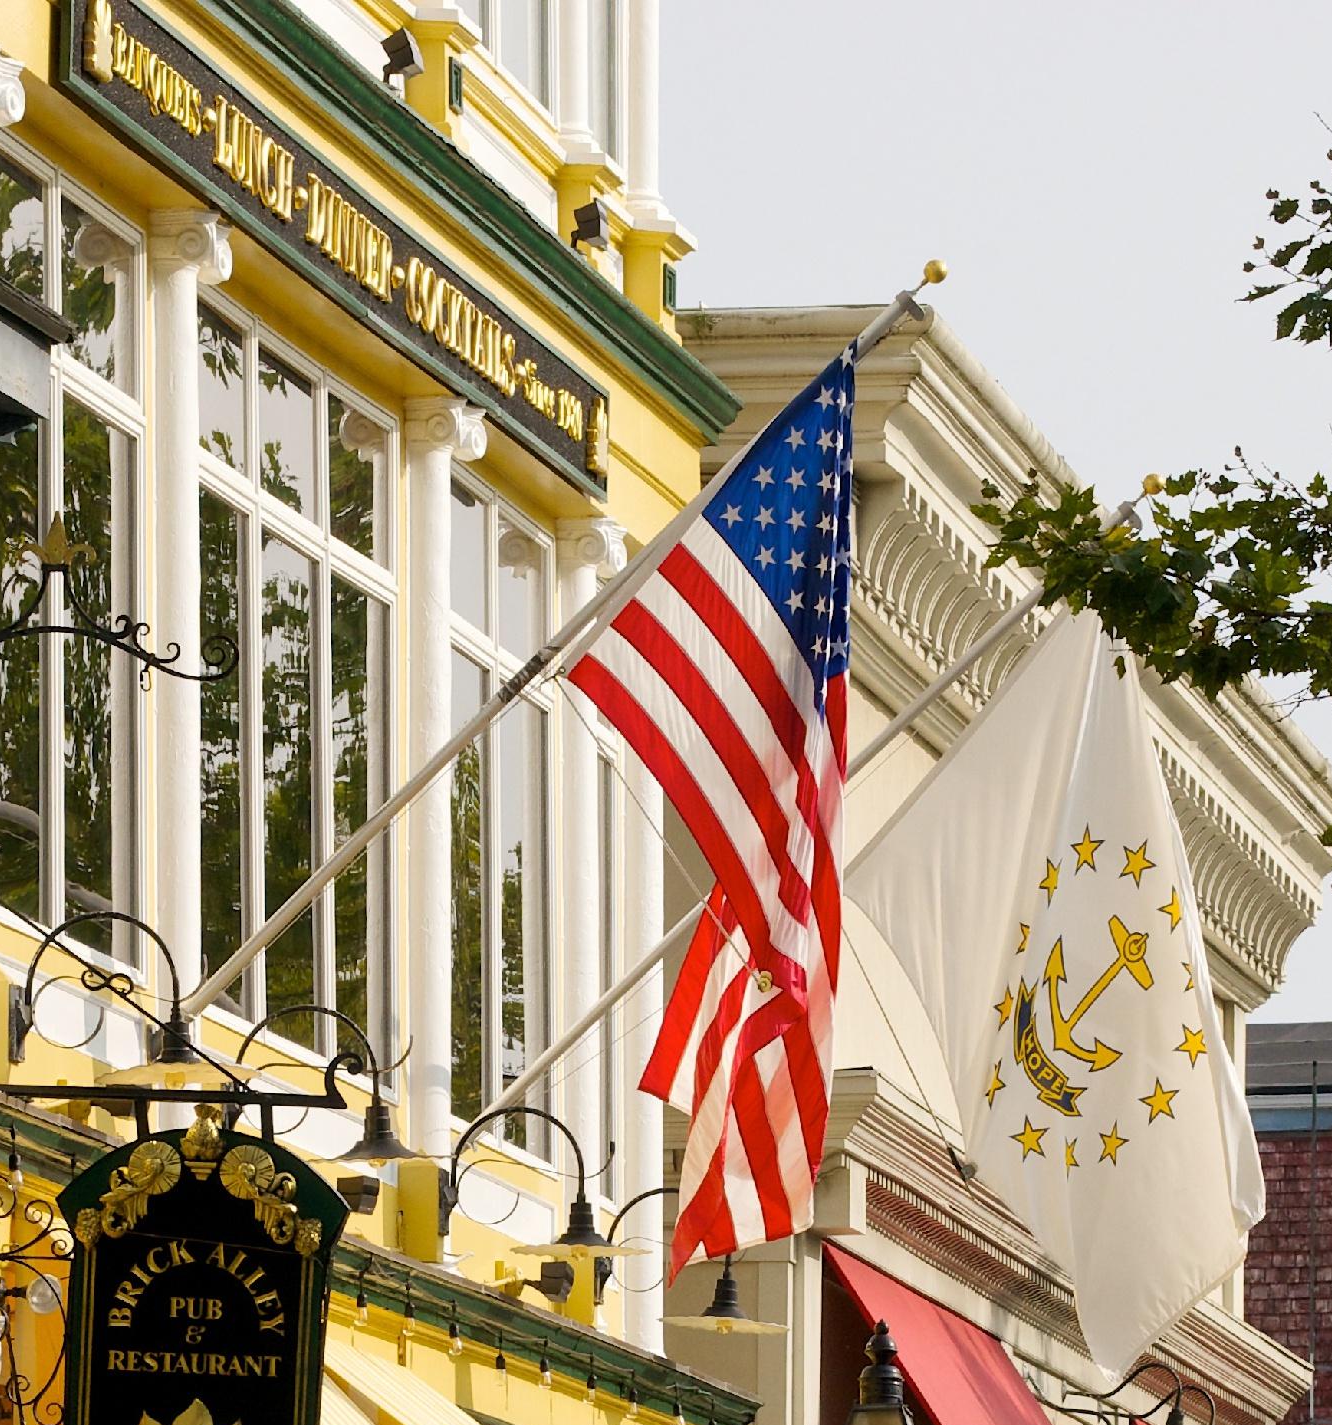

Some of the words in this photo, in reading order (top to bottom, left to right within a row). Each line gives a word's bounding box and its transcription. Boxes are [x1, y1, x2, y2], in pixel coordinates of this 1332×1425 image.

[213, 95, 295, 222] LUNCH
[305, 172, 393, 303] DINNER
[406, 257, 516, 398] COCKTAILS
[1025, 1031, 1065, 1094] HOPE
[107, 1239, 198, 1329] BRICK
[206, 1241, 286, 1338] ALLEY
[169, 1296, 223, 1321] PUB
[185, 1326, 208, 1345] &
[107, 1350, 283, 1379] RESTAURANT
